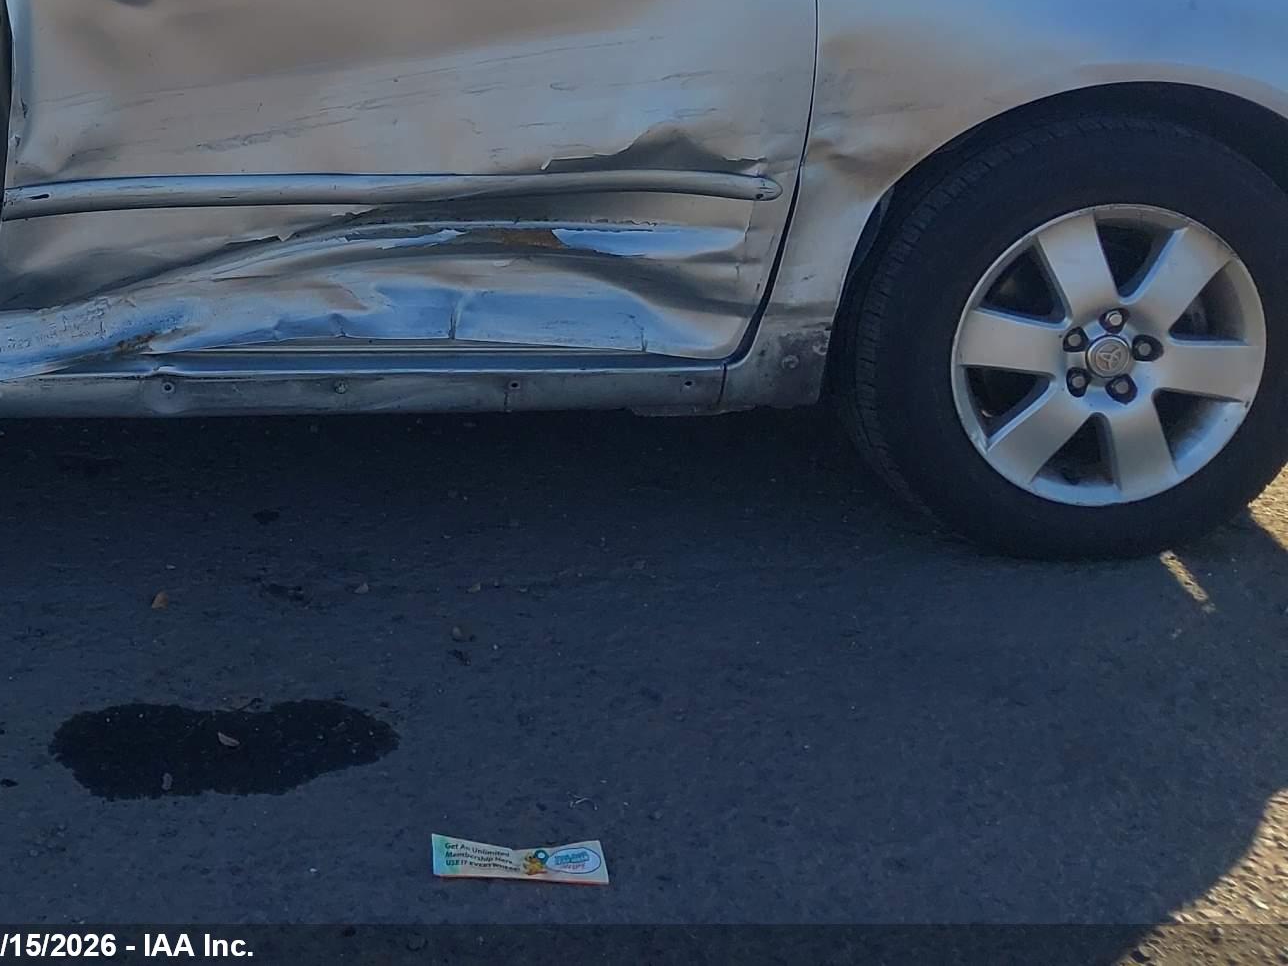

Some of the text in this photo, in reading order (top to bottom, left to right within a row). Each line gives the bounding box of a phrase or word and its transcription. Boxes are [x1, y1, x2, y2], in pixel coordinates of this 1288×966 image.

[445, 842, 458, 850] Get
[472, 847, 510, 857] Unlimited
[445, 851, 494, 863] Membership
